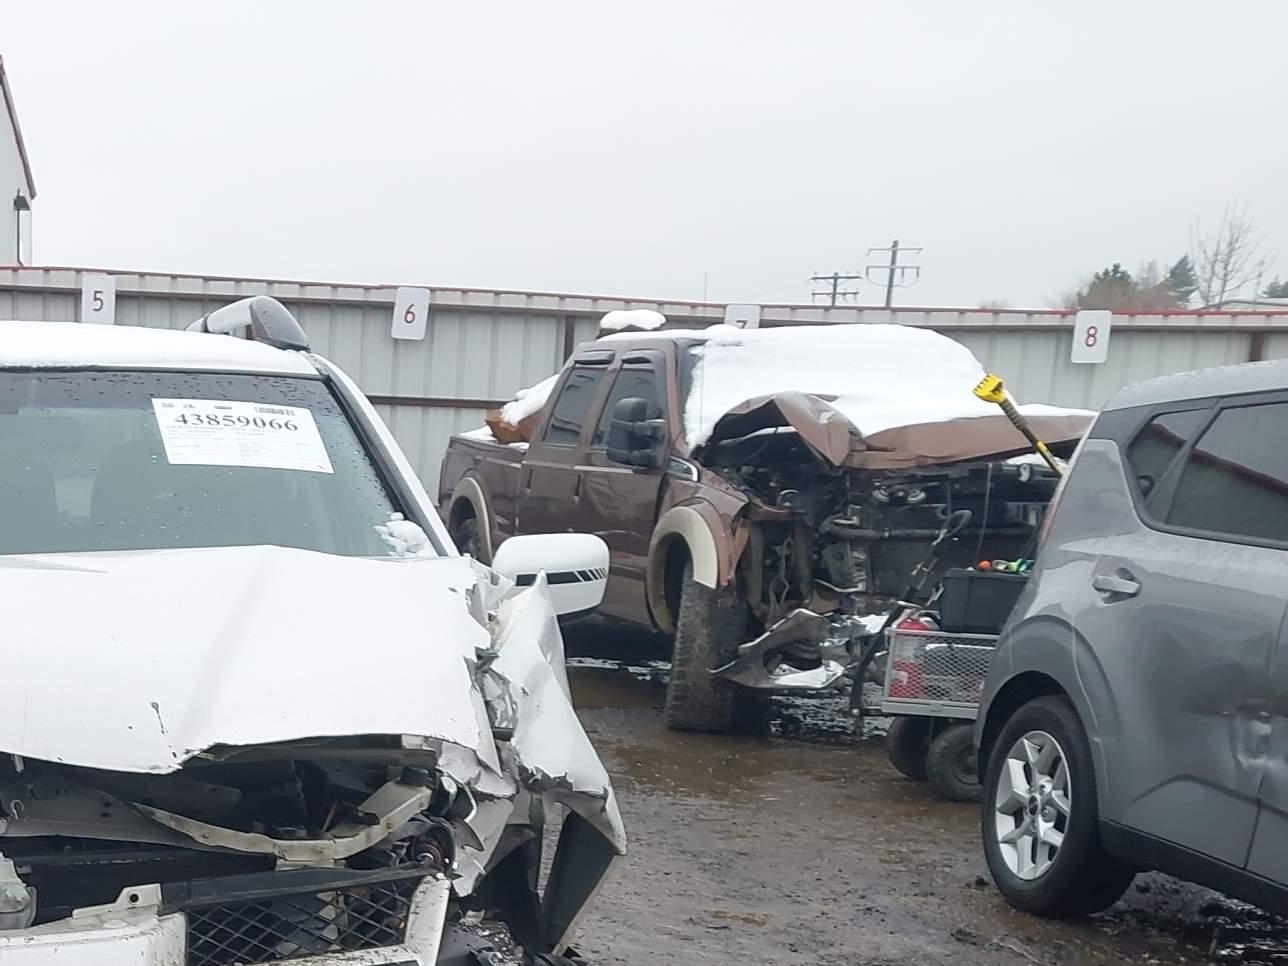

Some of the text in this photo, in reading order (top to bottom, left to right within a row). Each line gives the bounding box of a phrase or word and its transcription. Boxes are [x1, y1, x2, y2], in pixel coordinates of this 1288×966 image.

[92, 290, 104, 312] 5
[404, 303, 416, 324] 6
[1085, 326, 1098, 348] 8
[173, 412, 299, 432] 43859066
